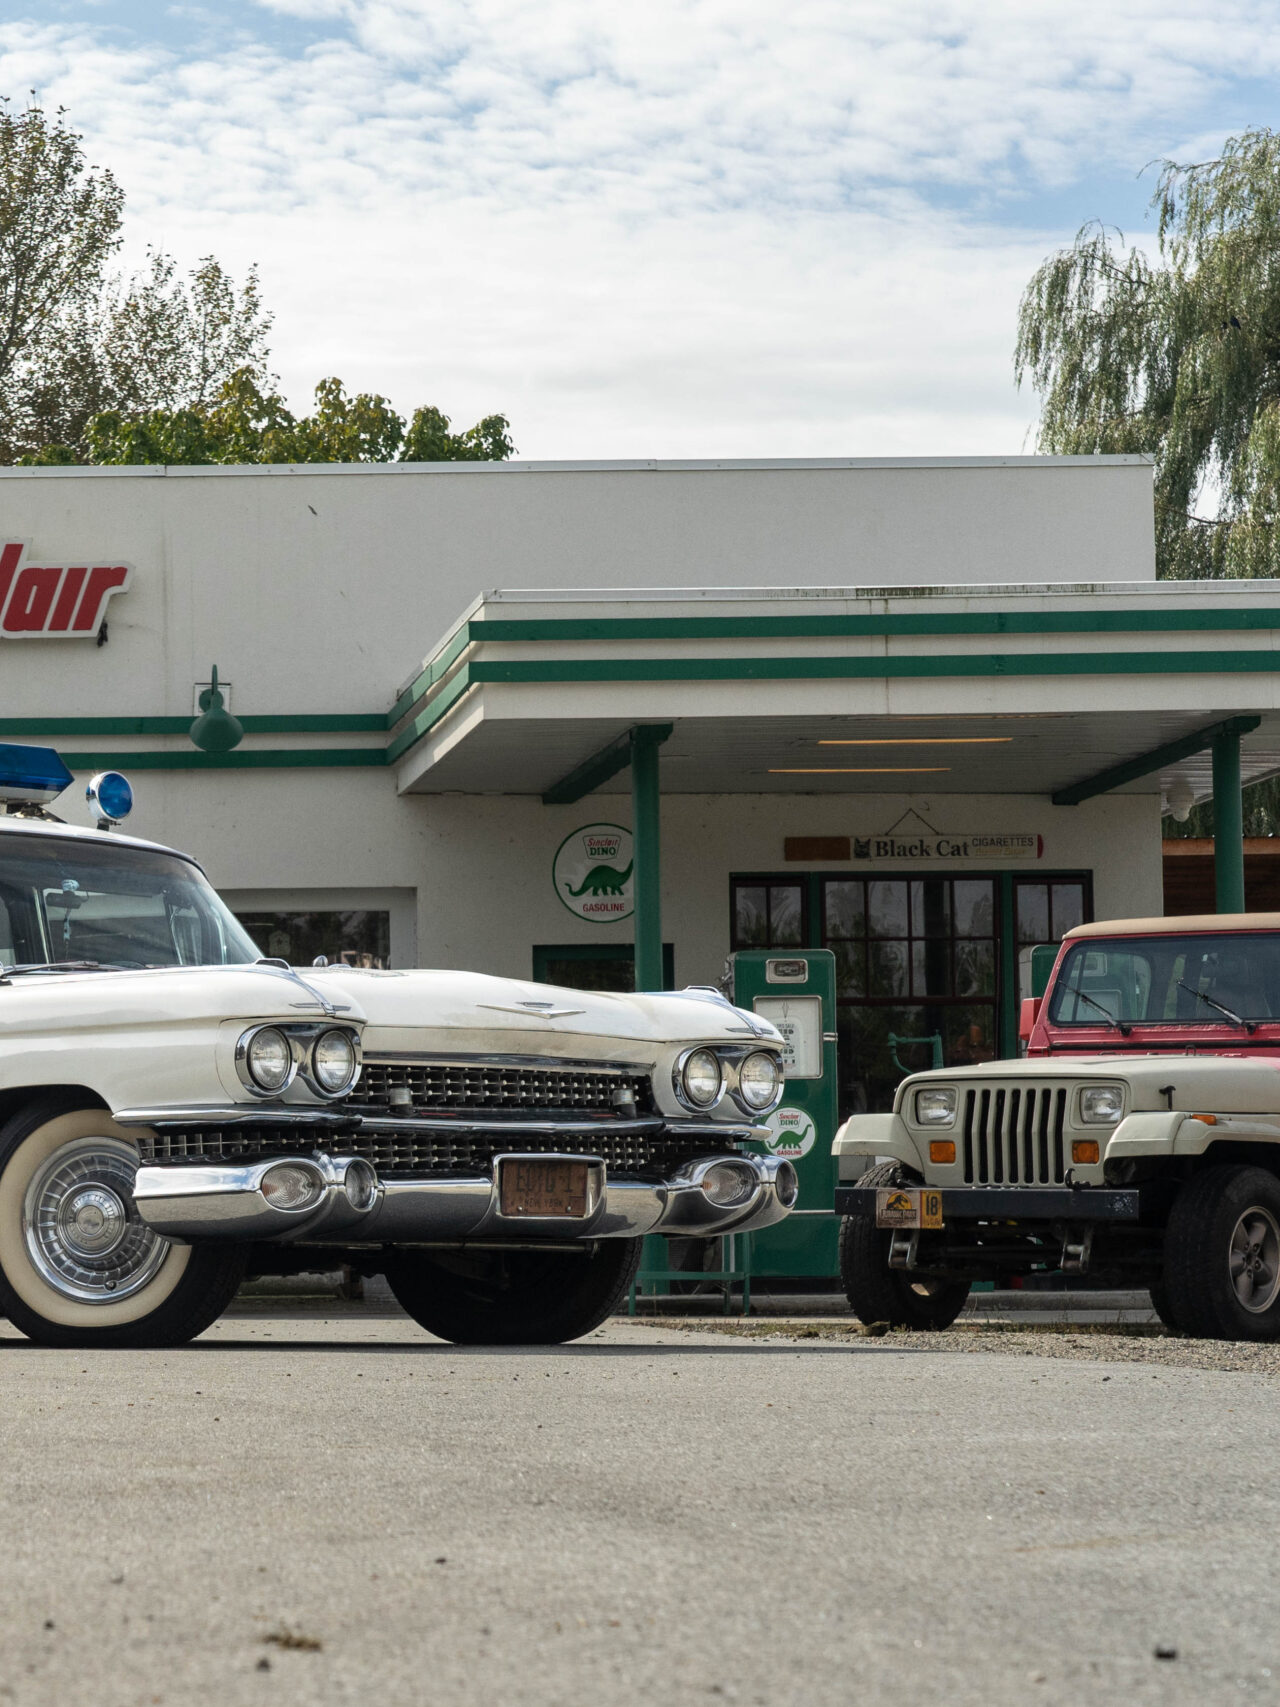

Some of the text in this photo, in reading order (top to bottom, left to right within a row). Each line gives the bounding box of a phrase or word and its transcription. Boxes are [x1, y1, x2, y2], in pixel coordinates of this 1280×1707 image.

[587, 838, 618, 847] Sinclair
[971, 837, 1034, 847] CIGARETTES
[589, 847, 617, 856] DINO
[875, 839, 969, 857] Black Cat
[582, 903, 625, 912] GASOLINE
[926, 1195, 938, 1216] 18
